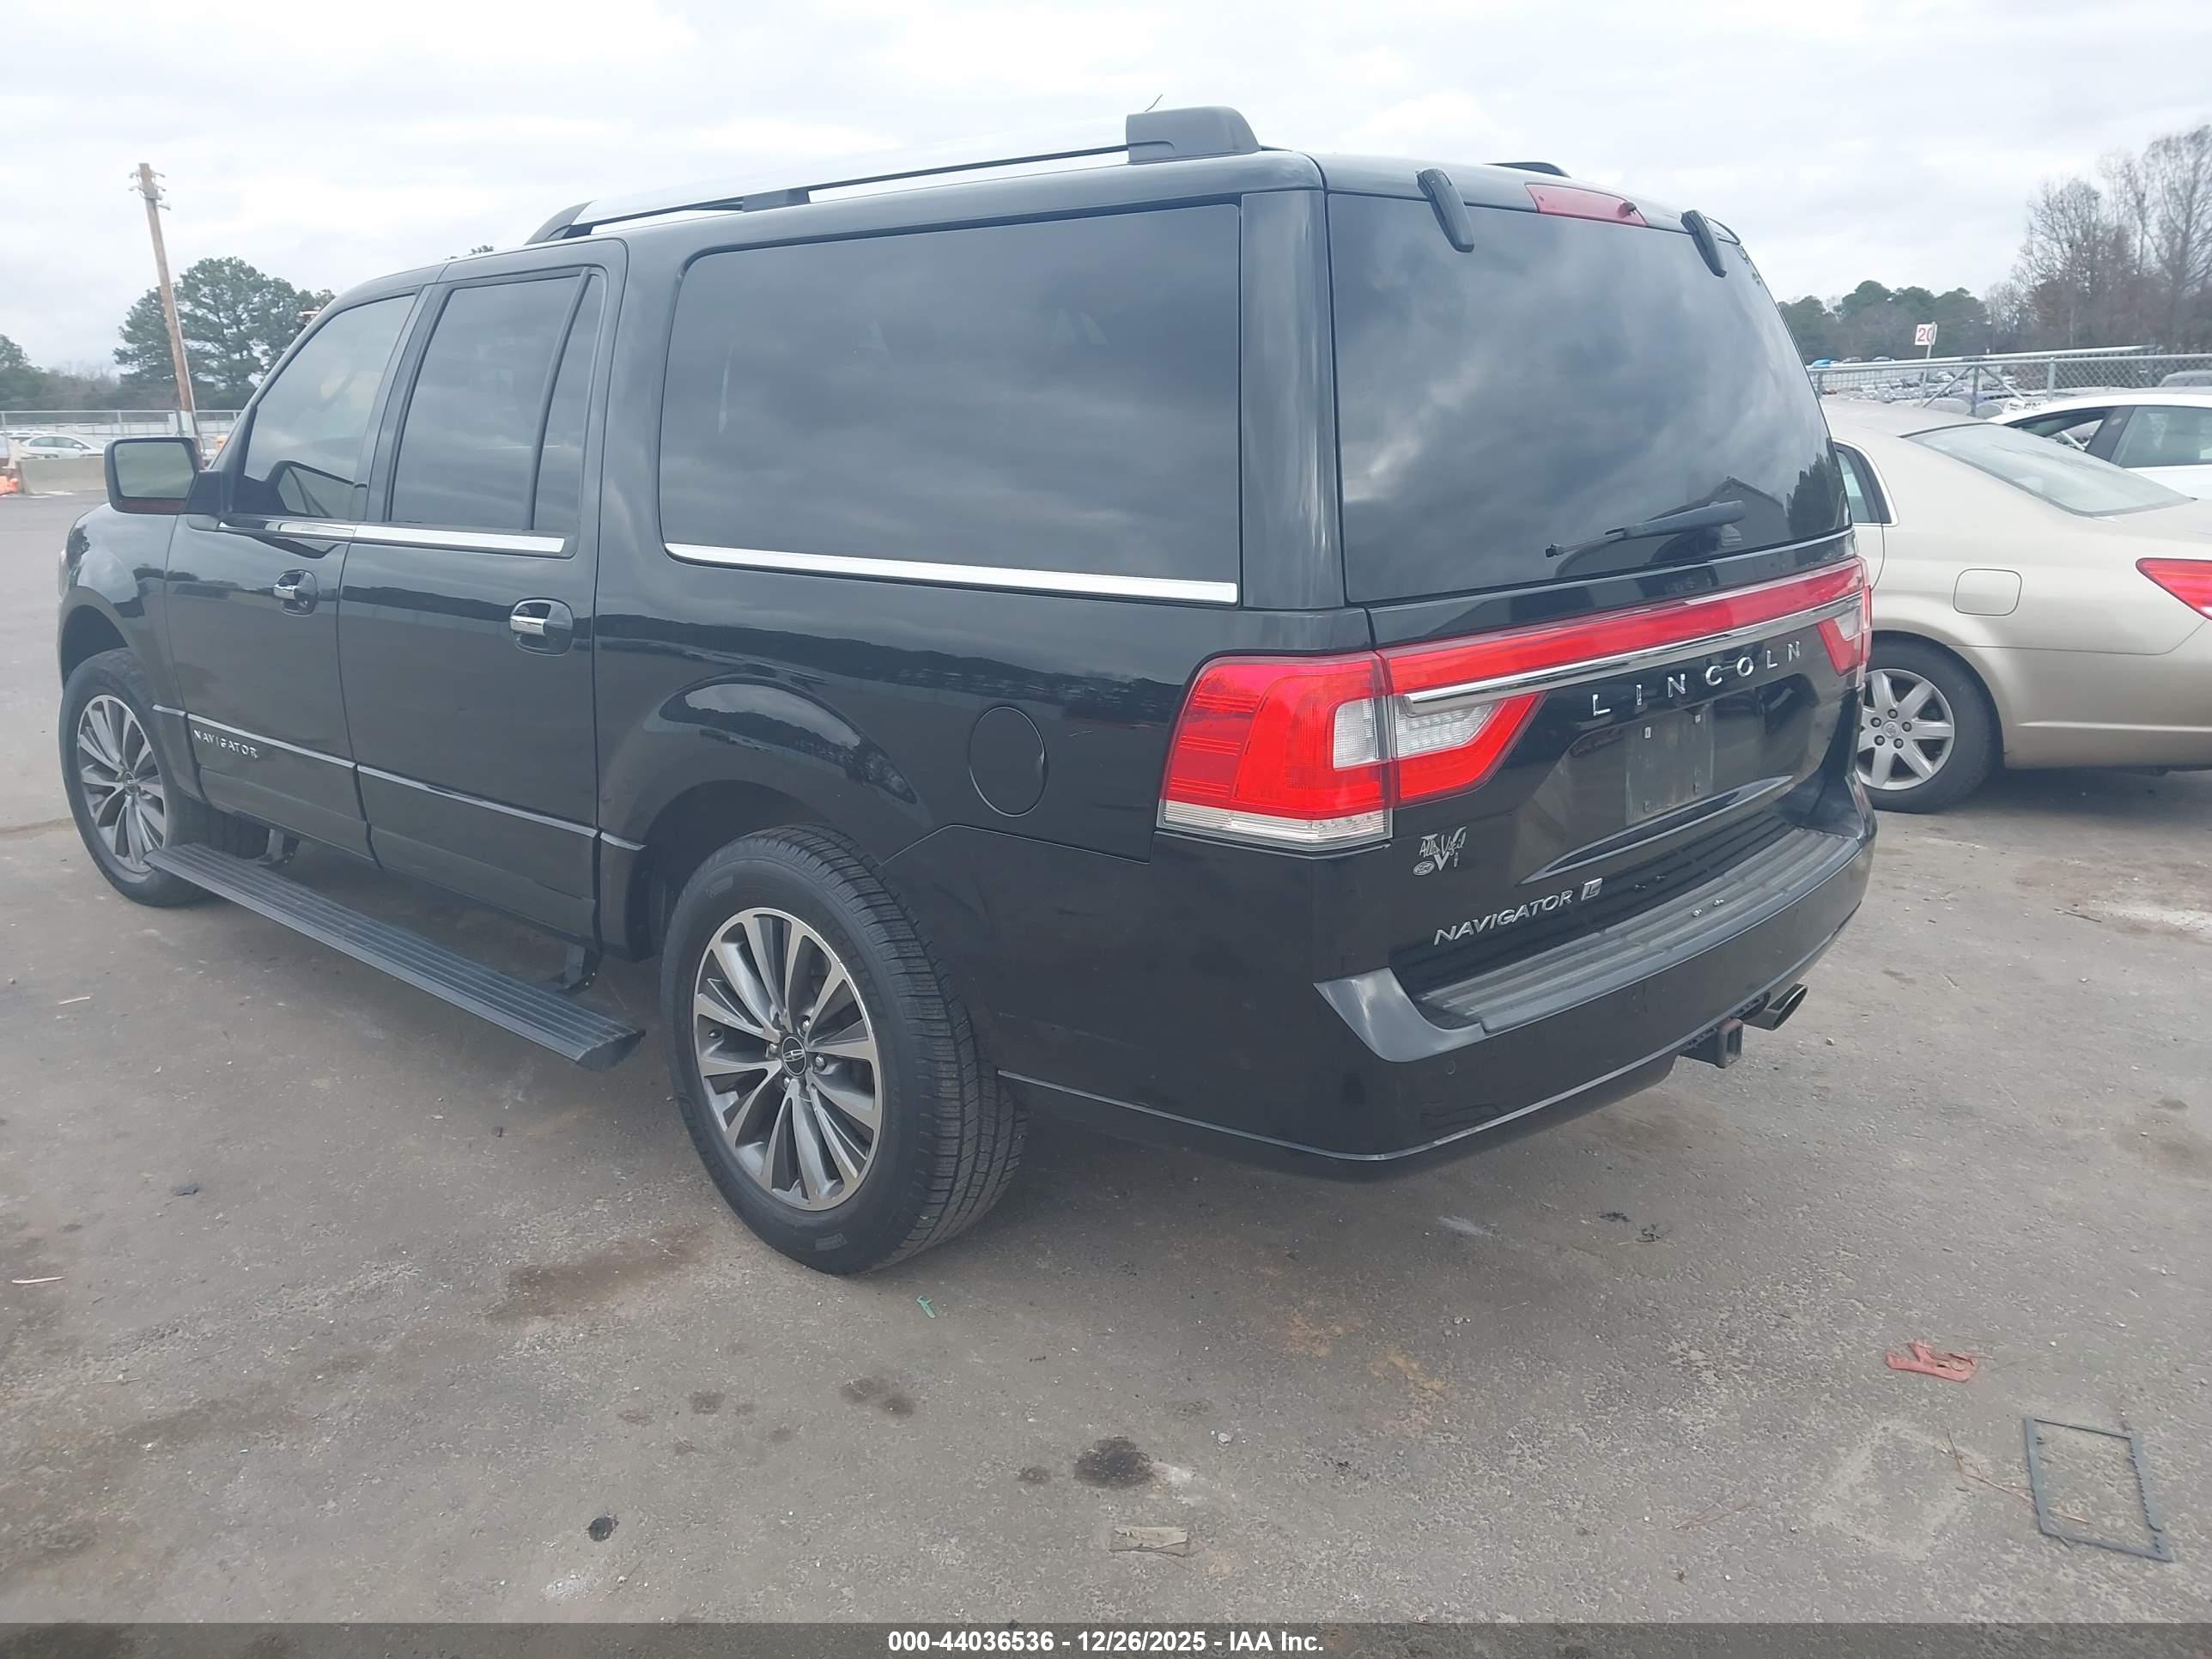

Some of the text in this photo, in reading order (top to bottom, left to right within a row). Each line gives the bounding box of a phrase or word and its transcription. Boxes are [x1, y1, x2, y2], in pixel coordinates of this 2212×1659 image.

[1916, 327, 1936, 343] 20
[1592, 641, 1801, 717] LINCOLN
[193, 729, 258, 759] NAVIGATOR
[1434, 890, 1573, 945] NAVIGATOR
